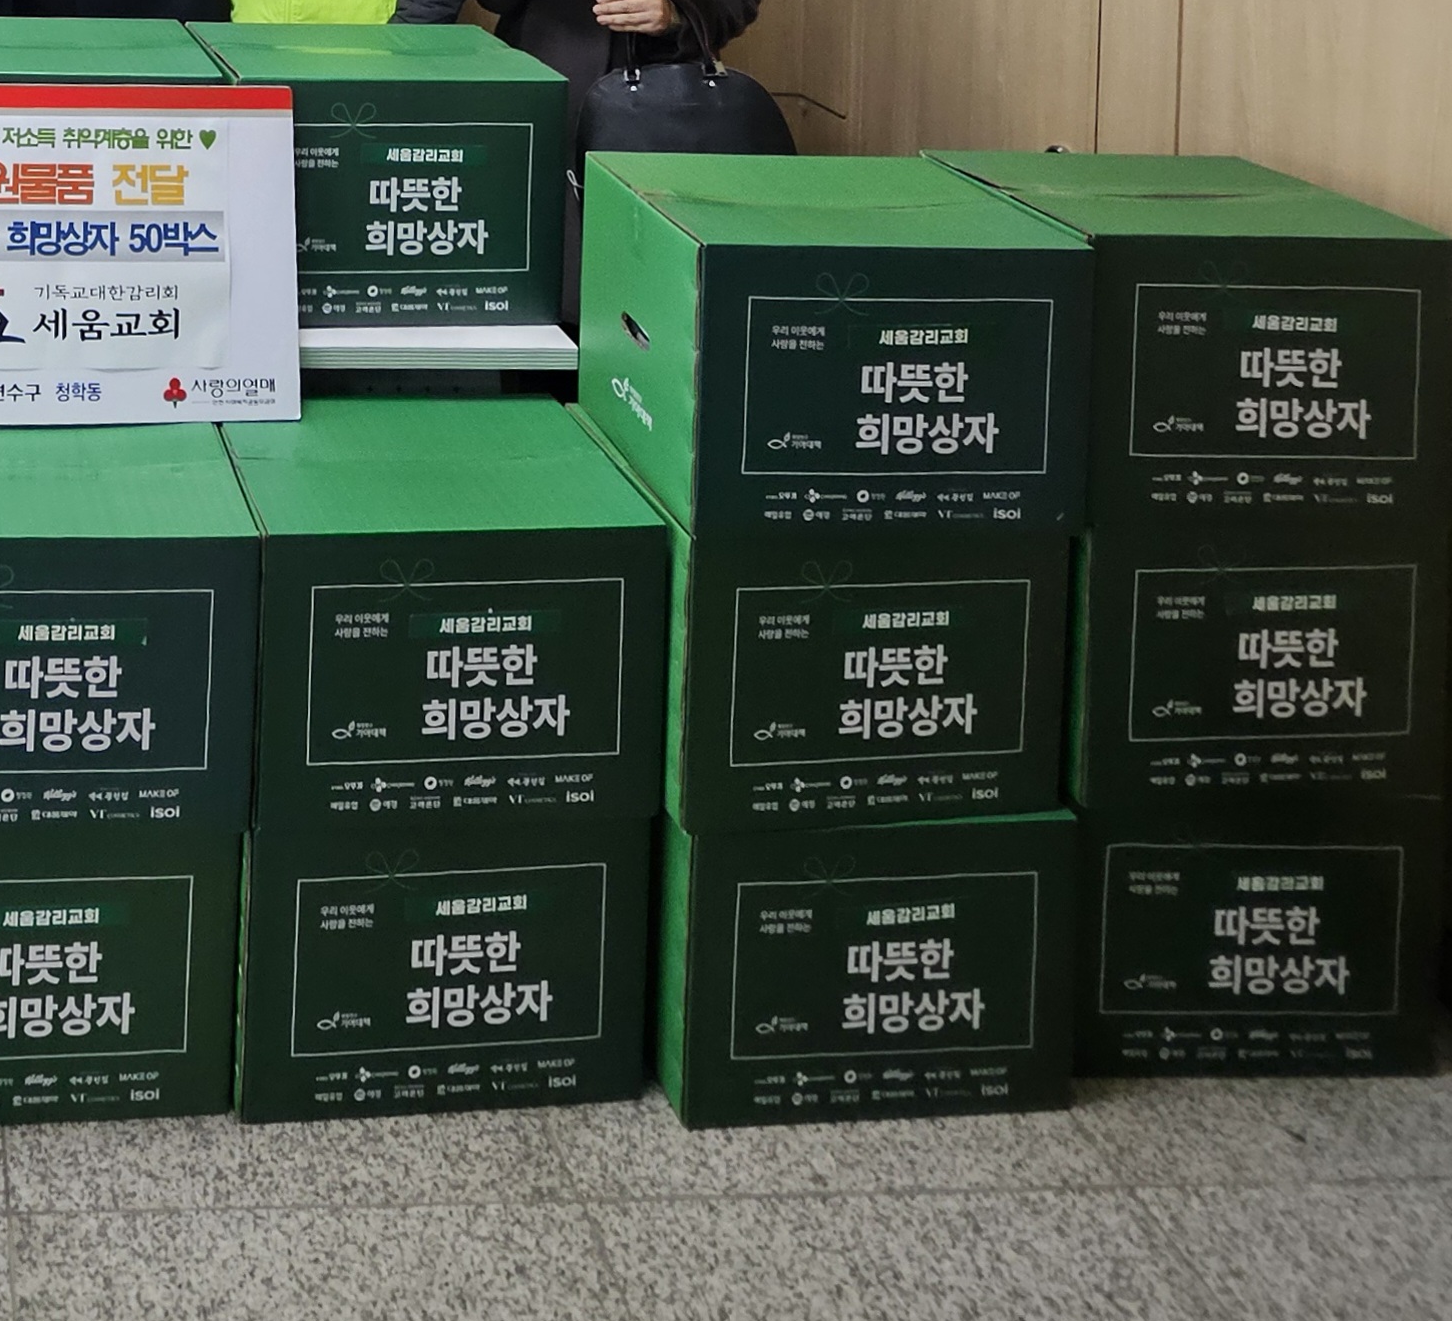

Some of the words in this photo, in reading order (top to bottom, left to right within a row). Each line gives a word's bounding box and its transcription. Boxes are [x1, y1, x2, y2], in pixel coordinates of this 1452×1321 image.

[2, 126, 56, 148] 저소득
[63, 127, 149, 150] 취약계층을
[156, 129, 192, 150] 위한
[112, 163, 188, 206] 전달
[370, 177, 462, 212] 따뜻한
[7, 220, 119, 256] 희망상자
[129, 221, 219, 255] 50박스
[366, 220, 488, 255] 희망상자
[34, 284, 179, 302] 기독교대한감리회
[33, 307, 180, 341] 세움교회
[192, 378, 275, 398] 사랑의열매
[861, 362, 968, 403] 따뜻한
[1241, 347, 1342, 388] 따뜻한
[56, 381, 102, 402] 청학동
[856, 413, 999, 454] 희망상자
[1236, 398, 1371, 439] 희망상자
[427, 644, 537, 688] 따뜻한
[844, 644, 948, 688] 따뜻한
[1239, 628, 1339, 669] 따뜻한
[5, 656, 122, 699] 따뜻한
[1233, 677, 1367, 718] 희망상자
[0, 708, 155, 752] 희망상자
[422, 695, 570, 740] 희망상자
[839, 694, 977, 739] 희망상자
[1214, 906, 1320, 945] 따뜻한
[411, 931, 521, 976] 따뜻한
[848, 938, 954, 982] 따뜻한
[1208, 955, 1349, 994] 희망상자
[406, 980, 553, 1028] 희망상자
[842, 988, 985, 1034] 희망상자
